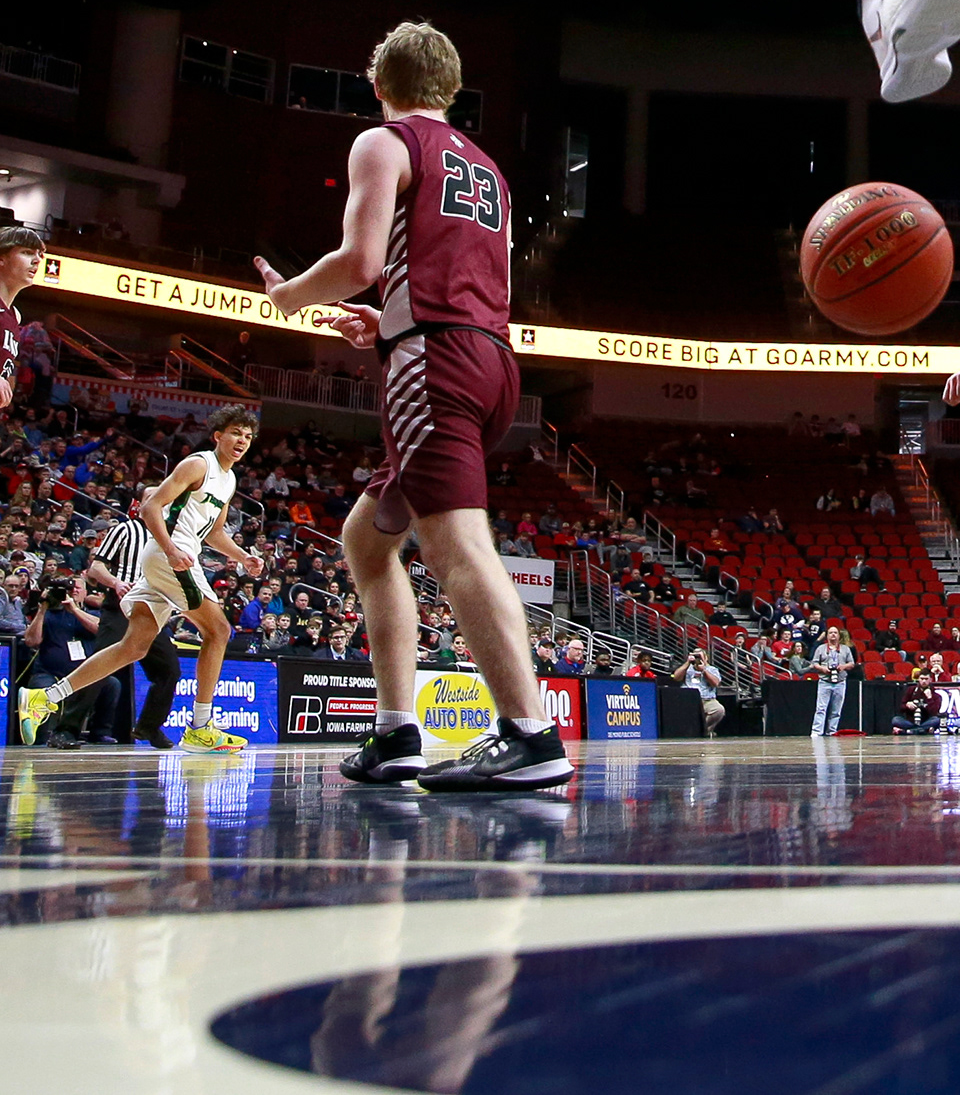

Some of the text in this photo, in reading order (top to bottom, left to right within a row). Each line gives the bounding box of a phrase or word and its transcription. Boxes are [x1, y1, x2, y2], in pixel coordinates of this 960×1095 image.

[440, 149, 502, 233] 23
[116, 274, 163, 300] GET
[169, 284, 184, 304] A
[191, 288, 253, 315] JUMP
[597, 337, 930, 368] SCORE BIG AT GOARMY.COM
[661, 382, 698, 400] 120
[303, 674, 328, 686] PROUD
[329, 676, 348, 687] TITLE
[433, 676, 480, 704] Westside
[605, 694, 640, 710] VIRTUAL
[326, 722, 345, 733] IOWA
[345, 722, 366, 733] FARM
[423, 707, 490, 730] AUTO PROS
[606, 710, 641, 726] CAMPUS
